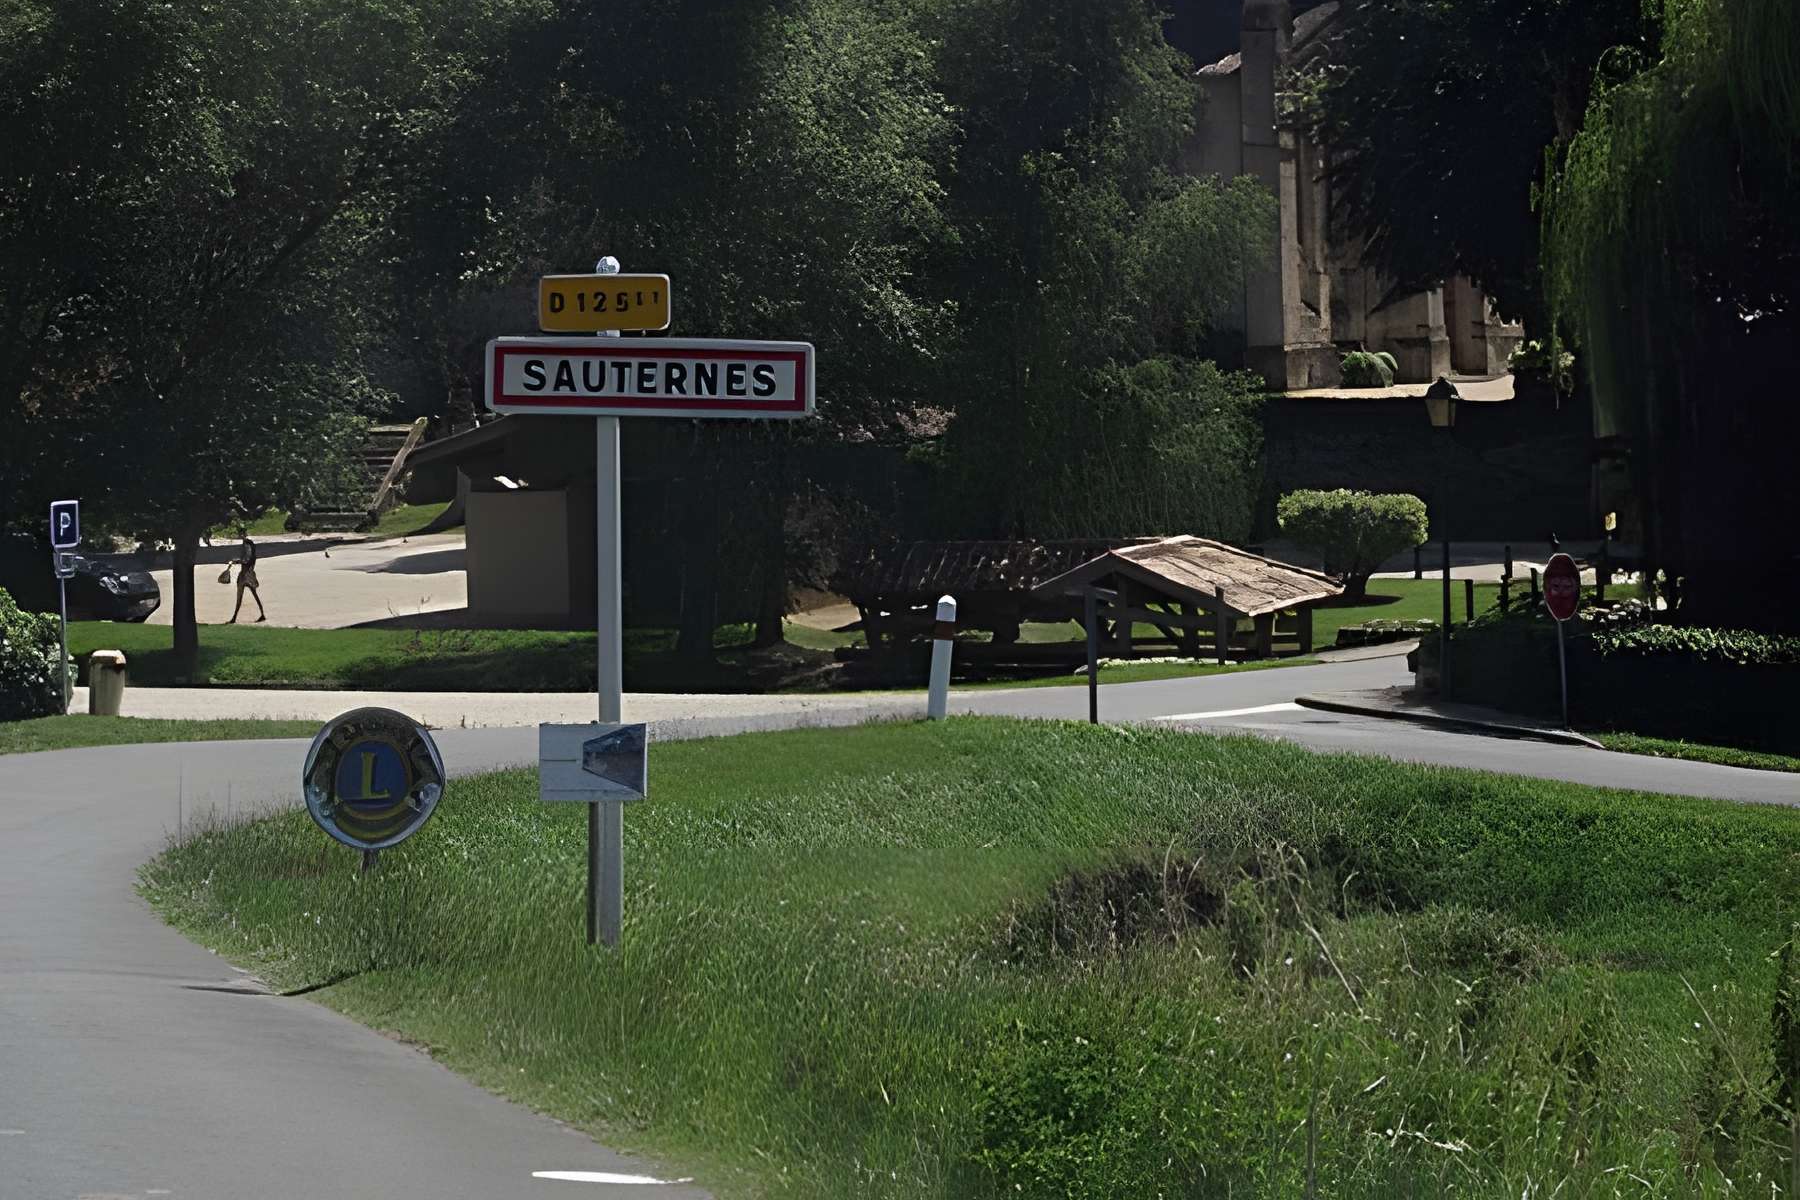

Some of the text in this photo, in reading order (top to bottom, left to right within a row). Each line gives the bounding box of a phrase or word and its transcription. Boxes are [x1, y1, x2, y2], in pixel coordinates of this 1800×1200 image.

[523, 359, 777, 397] SAUTERNES
[60, 512, 71, 536] P
[361, 752, 391, 799] L
